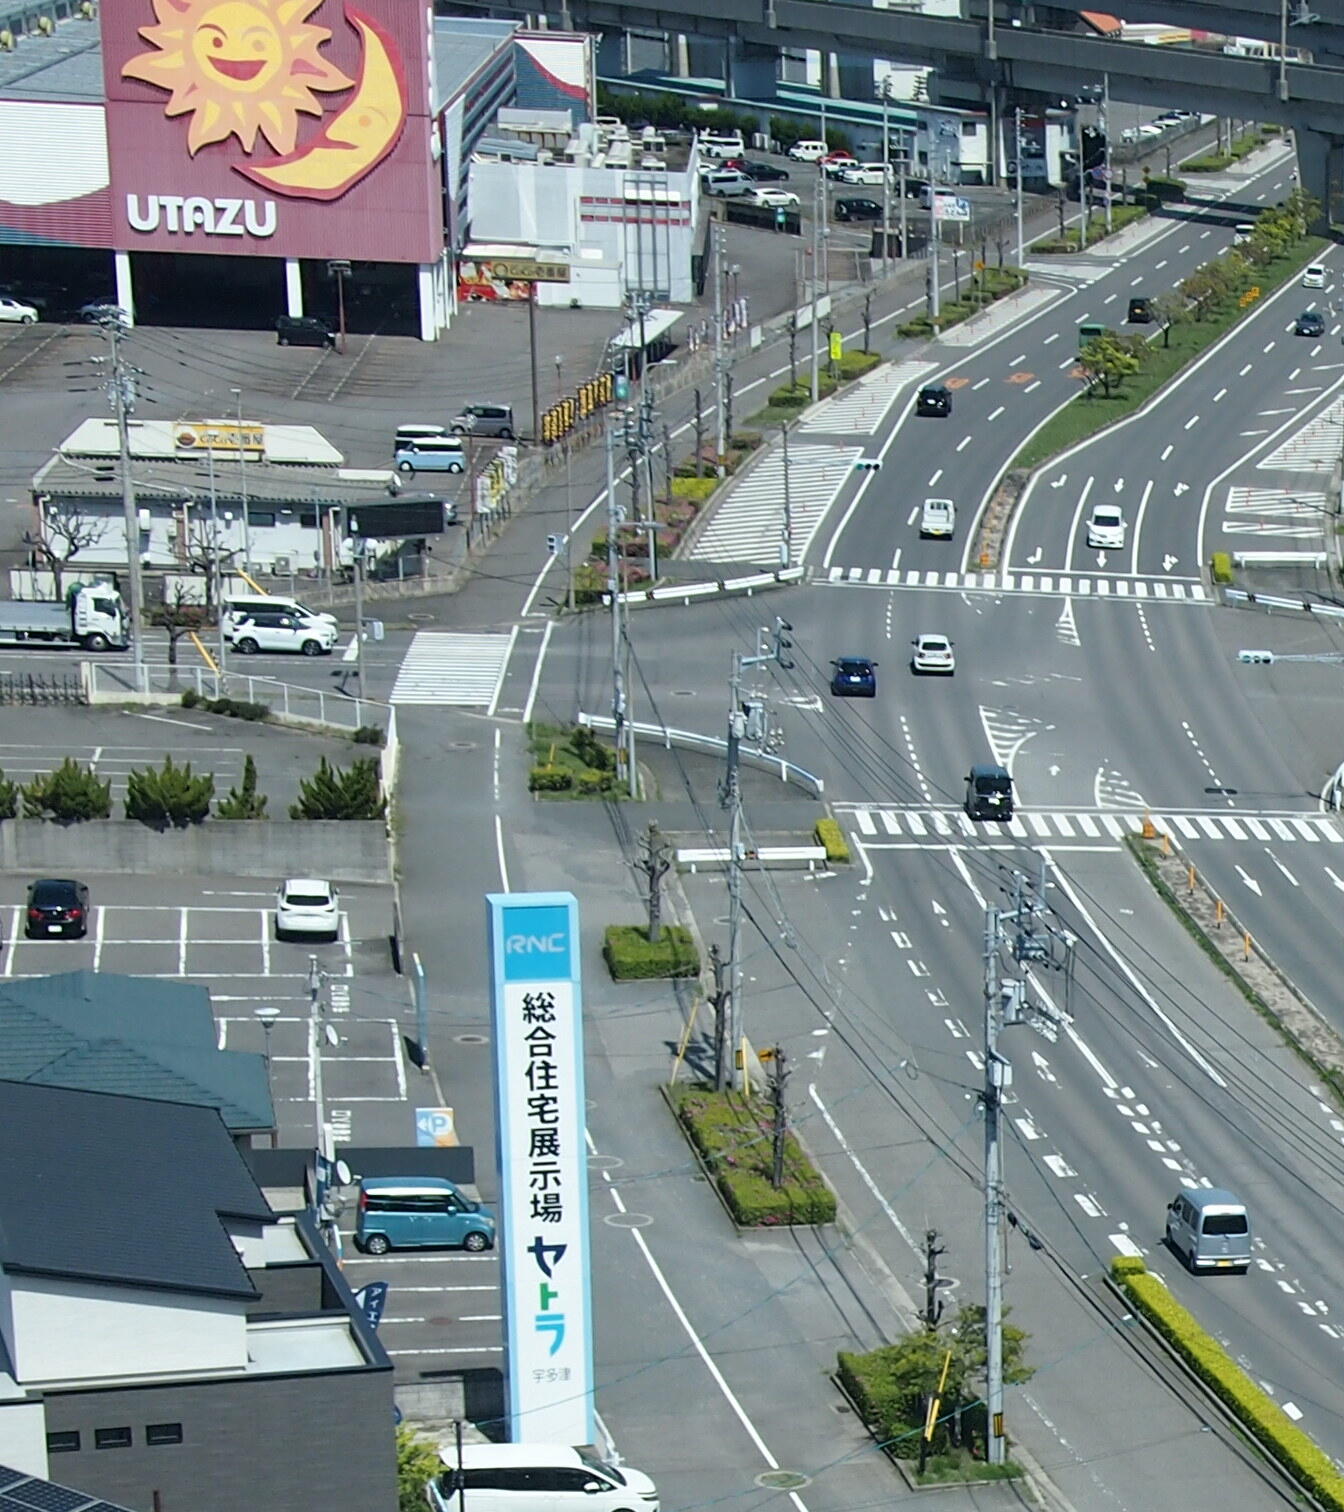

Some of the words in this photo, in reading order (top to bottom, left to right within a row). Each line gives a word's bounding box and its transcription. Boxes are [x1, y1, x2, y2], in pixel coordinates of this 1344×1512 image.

[126, 193, 277, 237] UTAZU
[506, 933, 566, 954] RNC
[522, 991, 563, 1224] 総合住宅展示場
[431, 1115, 446, 1133] P
[527, 1236, 568, 1357] ヤトラ
[532, 1367, 571, 1383] 宇多津
